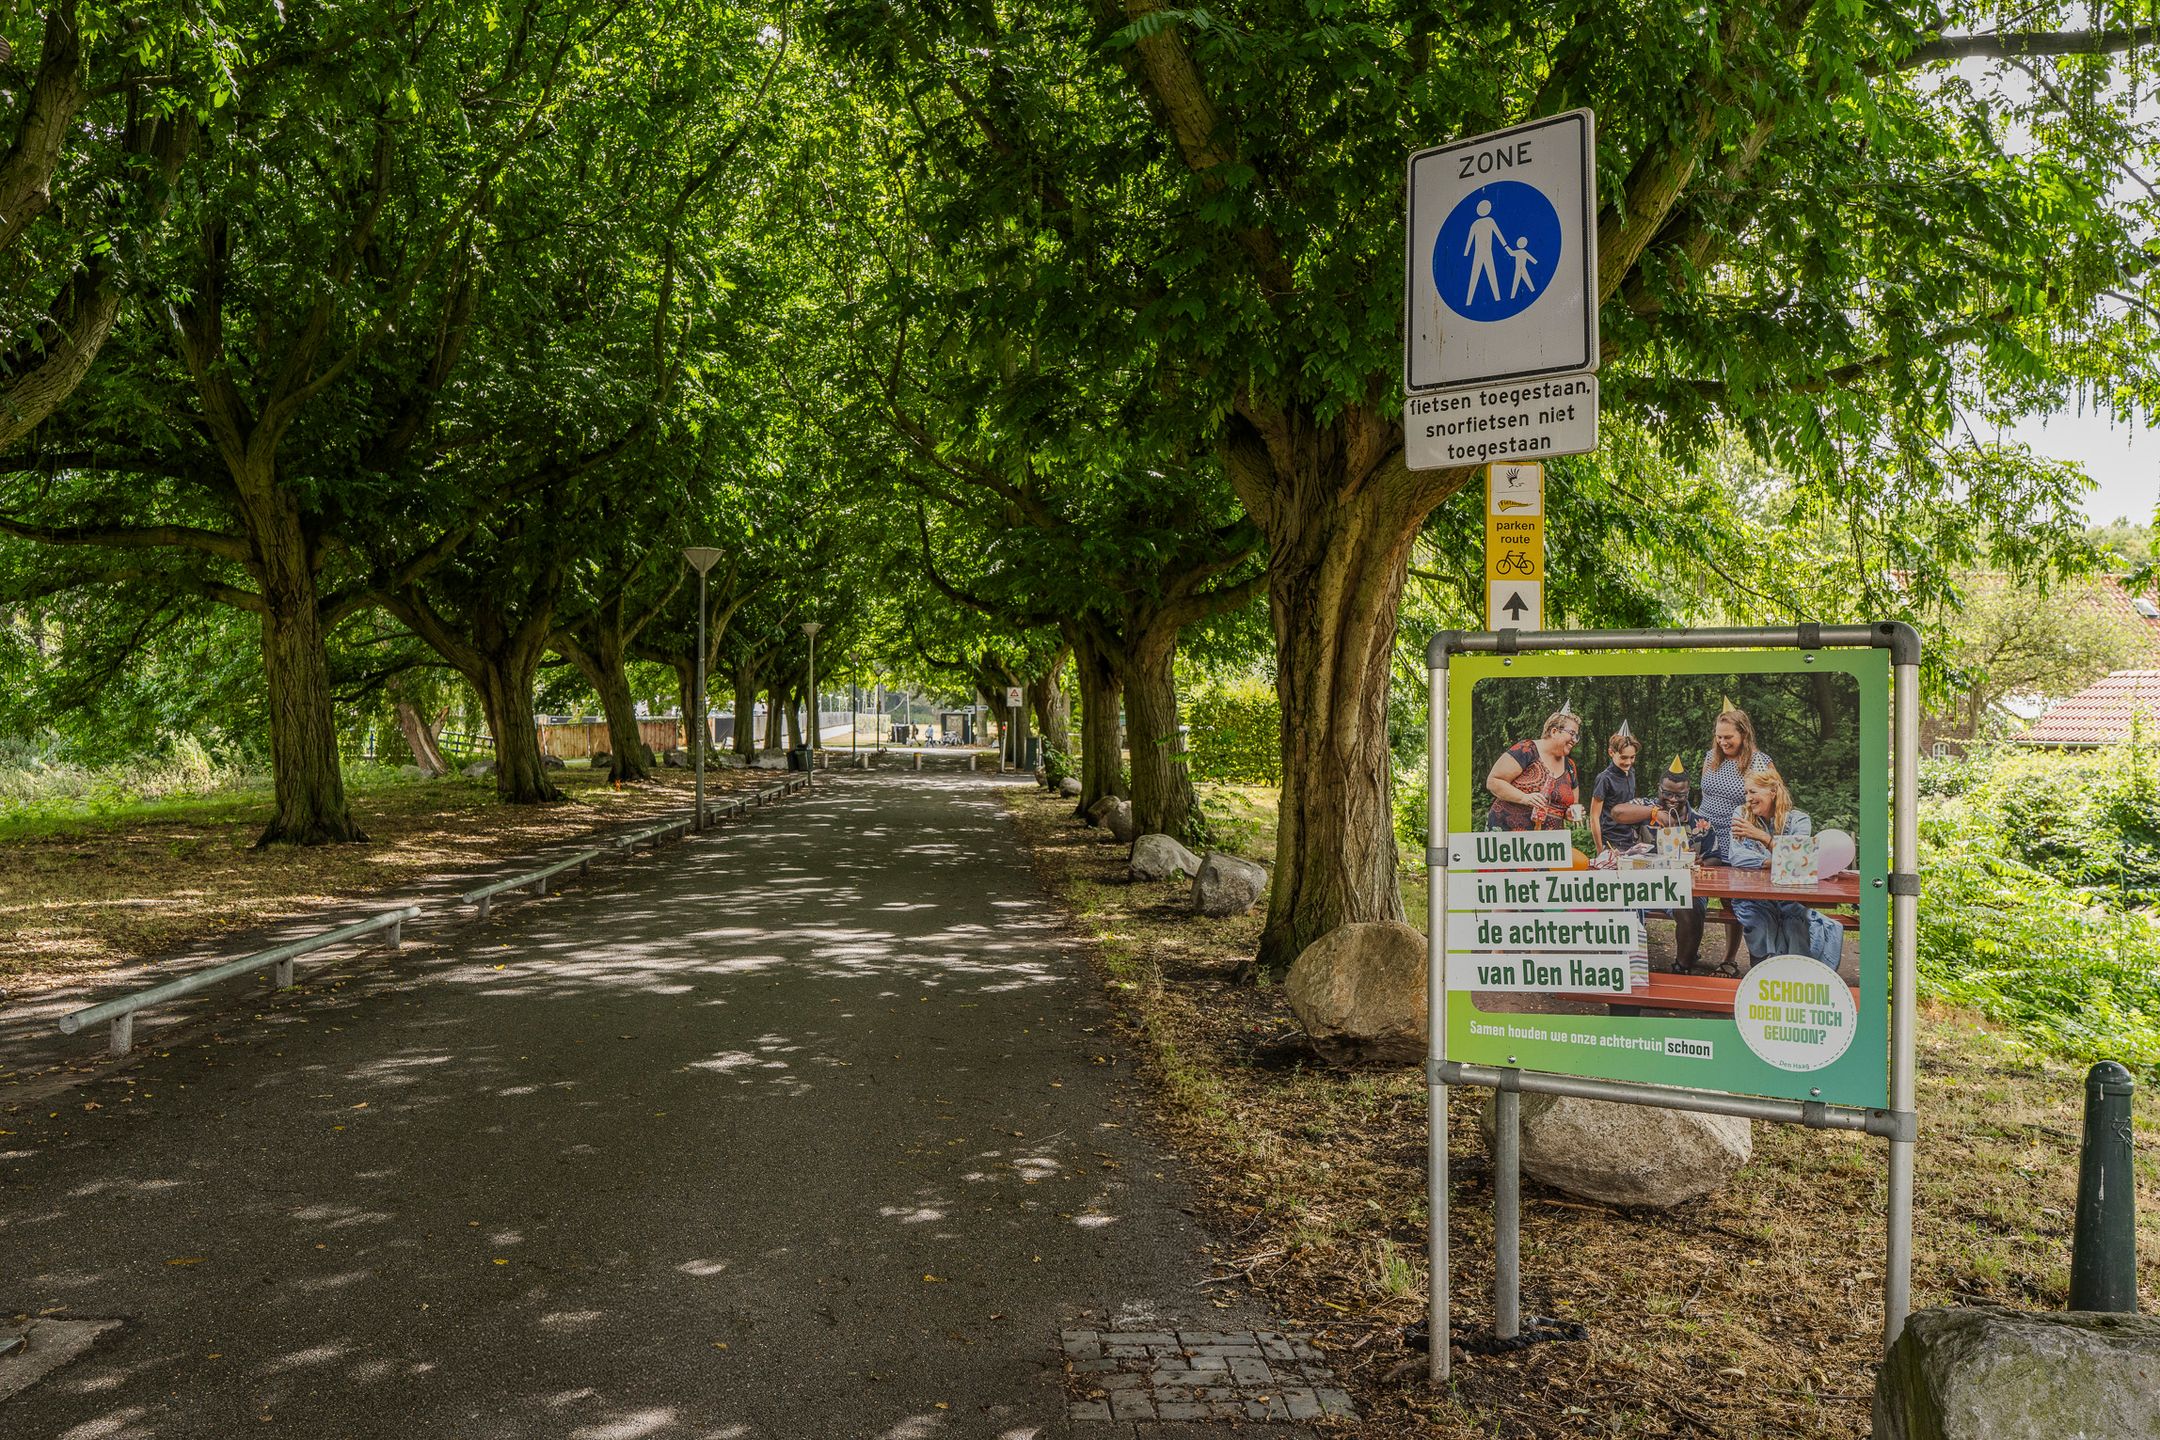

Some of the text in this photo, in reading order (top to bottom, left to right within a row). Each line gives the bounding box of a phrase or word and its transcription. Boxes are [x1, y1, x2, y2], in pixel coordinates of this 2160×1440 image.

[1458, 141, 1532, 179] ZONE
[1410, 380, 1591, 416] fietsen toegestaan,
[1426, 404, 1575, 438] snorfietsen niet
[1448, 436, 1551, 461] toegestaan
[1496, 520, 1535, 532] parken
[1500, 534, 1531, 544] route
[1476, 836, 1566, 863] Welkom
[1477, 875, 1686, 907] in het Zuiderpark,
[1477, 918, 1630, 944] de achtertuin
[1477, 959, 1625, 992] van Den Haag
[1758, 979, 1836, 1008] SCHOON,
[1749, 1004, 1842, 1027] DOEN WE TOCH
[1470, 1020, 1711, 1057] Samen houden we onze achtertuin schoon
[1764, 1025, 1827, 1045] GEWOON?
